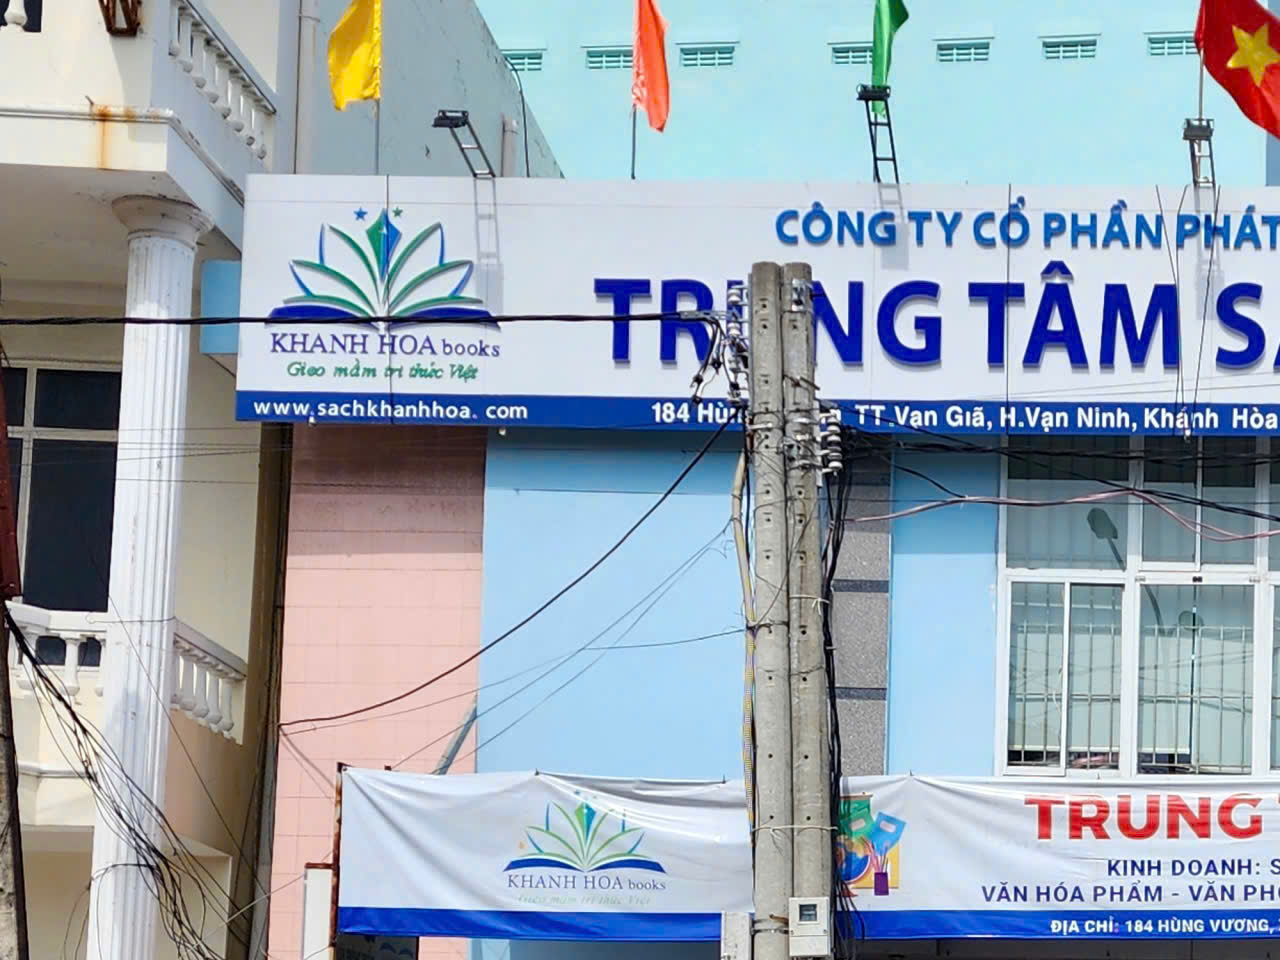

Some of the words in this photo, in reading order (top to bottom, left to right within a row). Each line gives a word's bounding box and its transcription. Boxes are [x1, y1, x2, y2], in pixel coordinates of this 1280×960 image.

[775, 200, 896, 247] CÔNG
[907, 209, 963, 248] TY
[973, 195, 1030, 249] CỔ
[1043, 198, 1163, 250] PHẦN
[594, 278, 942, 367] TRNG
[969, 261, 1180, 370] TÂM
[271, 333, 369, 354] KHANH
[378, 334, 437, 355] HOA
[442, 339, 500, 357] books
[652, 402, 690, 423] 184
[697, 401, 743, 424] Hùn
[1077, 407, 1137, 432] Ninh,
[1144, 405, 1218, 429] Khánh
[1233, 407, 1278, 430] Hòa
[1026, 792, 1264, 841] TRUNG
[1108, 859, 1162, 877] KINH
[1171, 858, 1260, 877] DOANH:
[508, 874, 576, 889] KHANH
[584, 875, 623, 890] HOA
[628, 879, 666, 890] books
[982, 882, 1028, 902] VĂN
[1036, 881, 1085, 902] HÓA
[1093, 880, 1163, 902] PHẨM
[1189, 880, 1235, 902] VĂN
[1051, 919, 1080, 936] ĐỊA
[1084, 915, 1119, 933] CHỈ:
[1125, 919, 1153, 933] 184
[1158, 916, 1204, 932] HÙNG
[1209, 917, 1274, 934] VƯƠNG,
